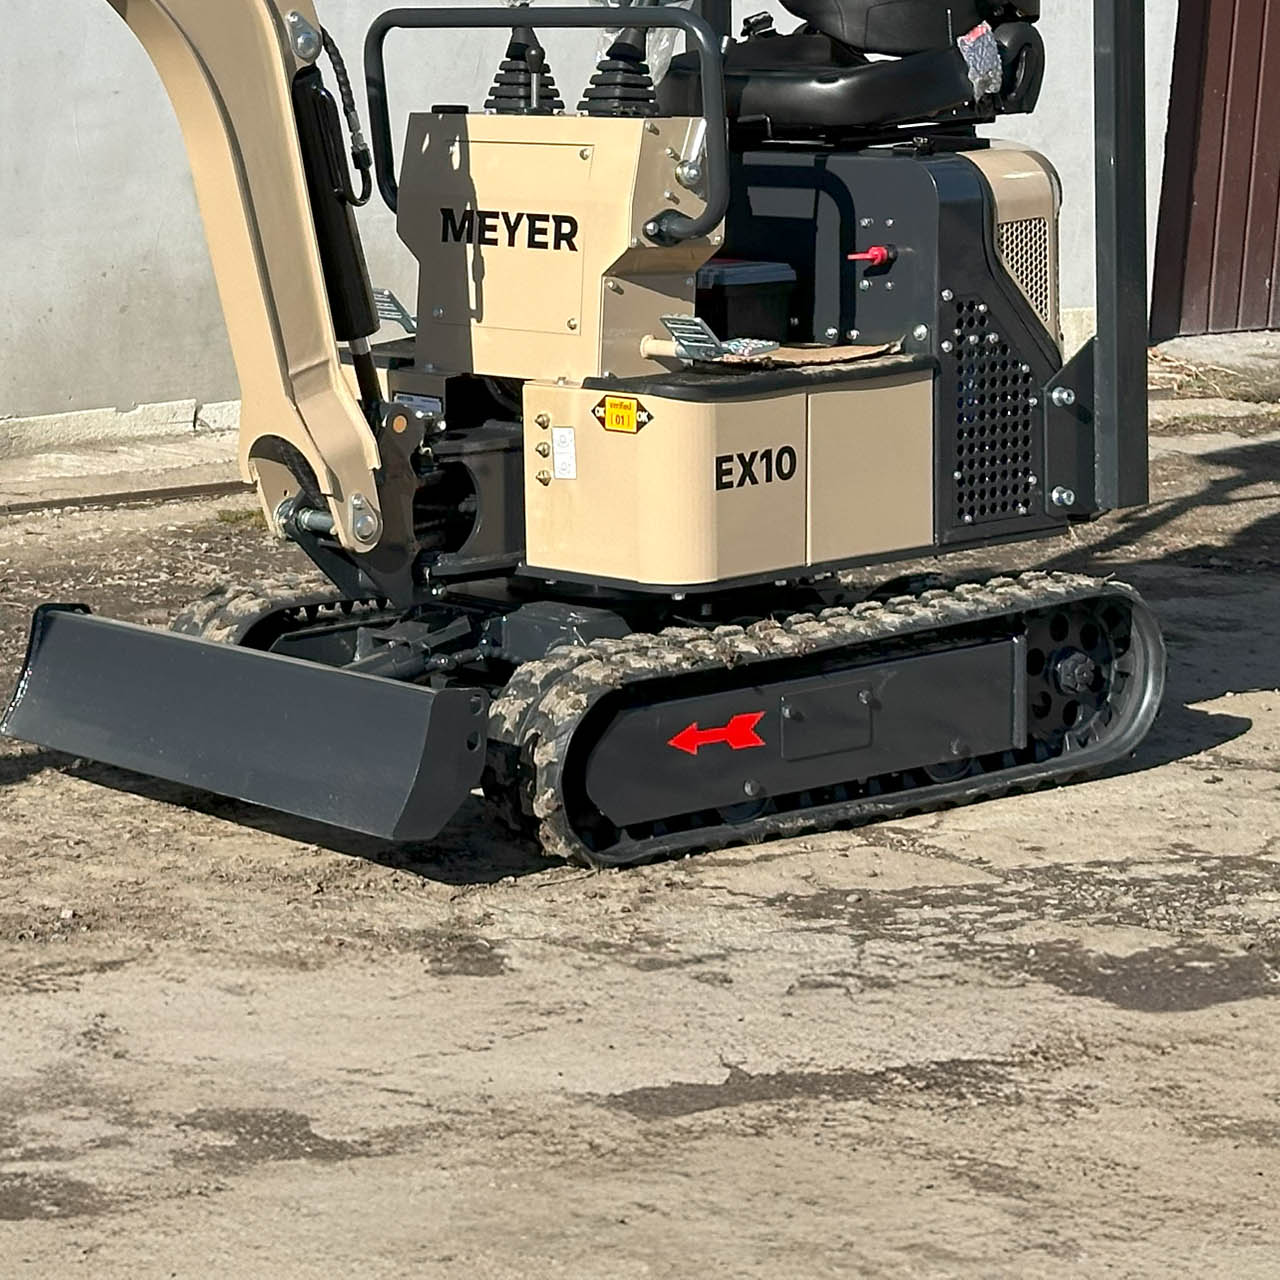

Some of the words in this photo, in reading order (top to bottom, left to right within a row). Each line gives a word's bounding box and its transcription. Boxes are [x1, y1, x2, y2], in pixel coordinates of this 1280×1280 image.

[440, 207, 579, 253] MEYER
[637, 411, 649, 422] OK
[715, 445, 797, 492] EX10
